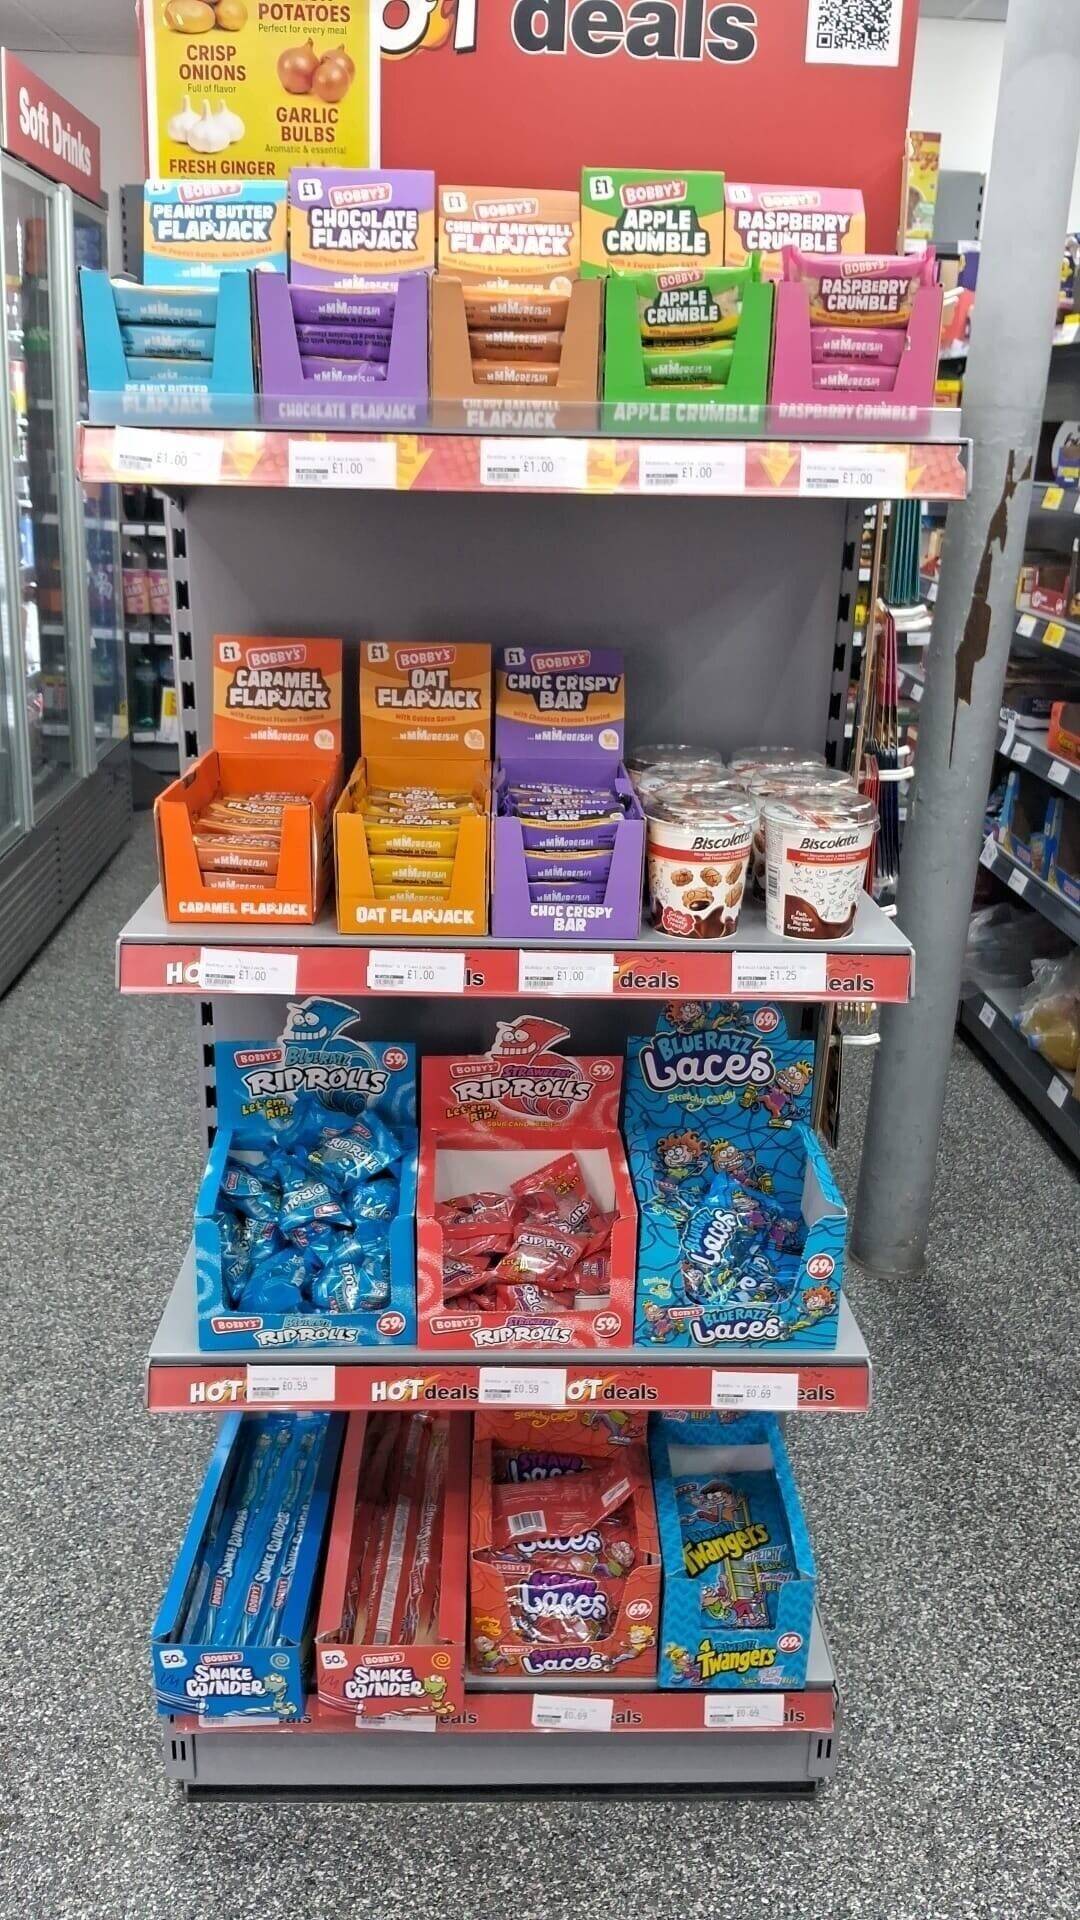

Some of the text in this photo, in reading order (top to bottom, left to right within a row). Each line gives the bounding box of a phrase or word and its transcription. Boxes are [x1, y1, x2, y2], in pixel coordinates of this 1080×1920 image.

[258, 3, 351, 23] POTATOES
[258, 24, 348, 36] Perfect for every meal
[511, 0, 758, 64] deals
[187, 44, 237, 62] CRISP
[179, 63, 246, 81] ONIONS
[187, 84, 237, 94] Full of flavor
[276, 107, 339, 124] GARLIC
[19, 87, 92, 177] Soft Drinks
[281, 126, 336, 142] BULBS
[265, 145, 347, 155] Aromatic & essential
[169, 159, 276, 176] FRESH GINGER
[594, 180, 608, 194] £1
[625, 182, 684, 203] BOBBY'S
[153, 204, 273, 221] PEANUT BUTTER
[311, 208, 419, 230] CHOCOLATE
[624, 209, 692, 231] APPLE
[738, 210, 850, 233] RASPBERRY
[158, 219, 271, 242] FLAPJACK
[311, 229, 418, 250] FLAPJACK
[450, 234, 570, 257] FLAPJACK
[605, 230, 707, 255] CRUMBLE
[746, 230, 838, 253] CRUMBLE
[660, 271, 702, 289] BOBBY'S
[821, 278, 910, 296] RASPBERRY
[658, 289, 707, 308] APPLE
[826, 294, 899, 312] CRUMBLE
[646, 305, 720, 324] CRUMBLE
[278, 402, 416, 420] CHOCOLATE FLAPJACK
[466, 409, 557, 429] FLAPJACK
[614, 400, 760, 423] APPLE CRUMBLE
[332, 462, 363, 475] £1.00
[523, 461, 555, 473] £1.00
[682, 465, 712, 478] £1.00
[843, 472, 872, 485] £1.00
[222, 644, 236, 660] £1
[250, 647, 302, 668] BOBBY'S
[370, 644, 385, 660] £1
[400, 648, 453, 667] BOBBY'S
[508, 650, 522, 664] £1
[536, 653, 586, 671] BOBBY'S
[236, 670, 322, 690] CARAMEL
[411, 669, 449, 689] OAT
[508, 674, 619, 692] CHOC CRISPY
[229, 688, 330, 709] FLAPJACK
[378, 688, 480, 709] FLAPJACK
[539, 690, 585, 710] BAR
[178, 901, 309, 917] CARAMEL FLAPJACK
[356, 907, 476, 925] OAT FLAPJACK
[530, 904, 614, 920] CHOC CRISPY
[553, 917, 587, 933] BAR
[238, 969, 267, 982] £1.00
[407, 969, 435, 981] £1.00
[557, 970, 584, 982] £1.00
[619, 970, 681, 990] deals
[769, 970, 798, 981] £1.25
[755, 1013, 777, 1027] 69p
[657, 1031, 753, 1063] BLUE RAZZ
[240, 1051, 281, 1064] BOBBY'S
[384, 1052, 407, 1067] 59p
[456, 1064, 498, 1075] BOBBY'S
[501, 1065, 575, 1079] STRAWBERRY
[591, 1064, 614, 1076] 59p
[644, 1050, 773, 1088] Laces
[706, 1090, 736, 1105] Candy
[266, 1105, 294, 1121] Rip!
[469, 1109, 498, 1123] Rip!
[518, 1233, 544, 1247] RIP
[807, 1259, 833, 1274] 69p
[217, 1319, 260, 1331] BOBBY'S
[378, 1316, 404, 1331] 59p
[436, 1317, 480, 1331] BOBBY'S
[594, 1317, 620, 1331] 59p
[691, 1318, 781, 1342] Laces
[190, 1379, 245, 1403] HOT
[283, 1380, 309, 1392] £0.59
[371, 1377, 479, 1403] HOT deals
[513, 1382, 539, 1394] £0.59
[566, 1377, 658, 1400] OT deals
[745, 1387, 772, 1399] £0.69
[683, 1523, 770, 1577] Twangers
[521, 1585, 608, 1619] Laces
[627, 1603, 651, 1617] 69p
[699, 1639, 713, 1652] 4
[163, 1653, 185, 1665] 50p
[202, 1653, 242, 1664] BOBBY'S
[325, 1654, 345, 1666] 50p
[365, 1653, 403, 1665] BOBBY'S
[523, 1655, 606, 1673] Laces
[696, 1648, 777, 1678] Twangers
[194, 1664, 253, 1682] SNAKE
[353, 1666, 413, 1684] SNAKE
